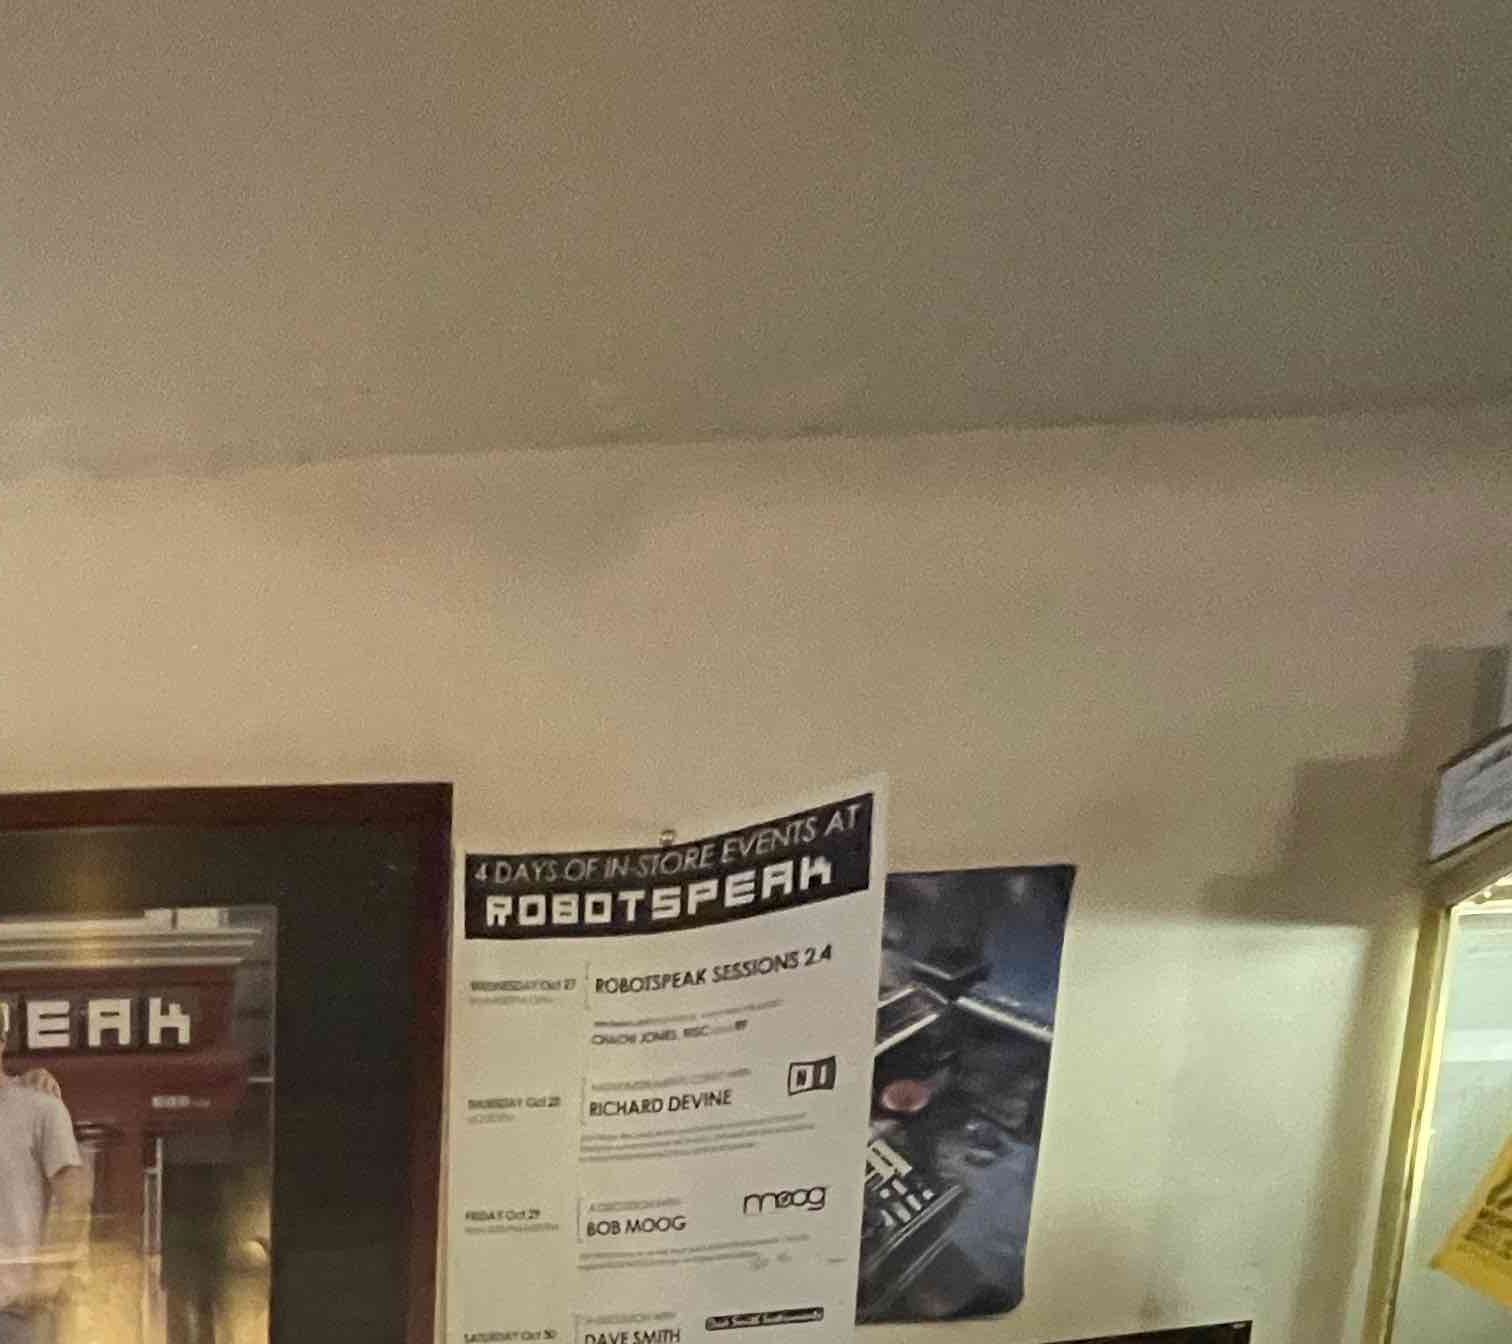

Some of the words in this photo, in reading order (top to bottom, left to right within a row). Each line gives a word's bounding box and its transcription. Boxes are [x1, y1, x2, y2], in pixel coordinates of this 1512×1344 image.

[474, 862, 488, 882] 4
[495, 860, 559, 885] DAYS
[565, 857, 600, 882] OF
[603, 846, 716, 879] IN-STORE
[721, 817, 818, 865] EVENTS
[823, 804, 861, 837] AT
[486, 855, 832, 927] ROBOTSPEAK
[594, 966, 707, 995] ROBOTSPEAK
[712, 951, 800, 983] SESSIONS
[589, 1098, 664, 1118] RICHARD
[668, 1089, 733, 1113] DEVINE
[586, 1219, 621, 1237] BOB
[625, 1215, 688, 1235] MOOG
